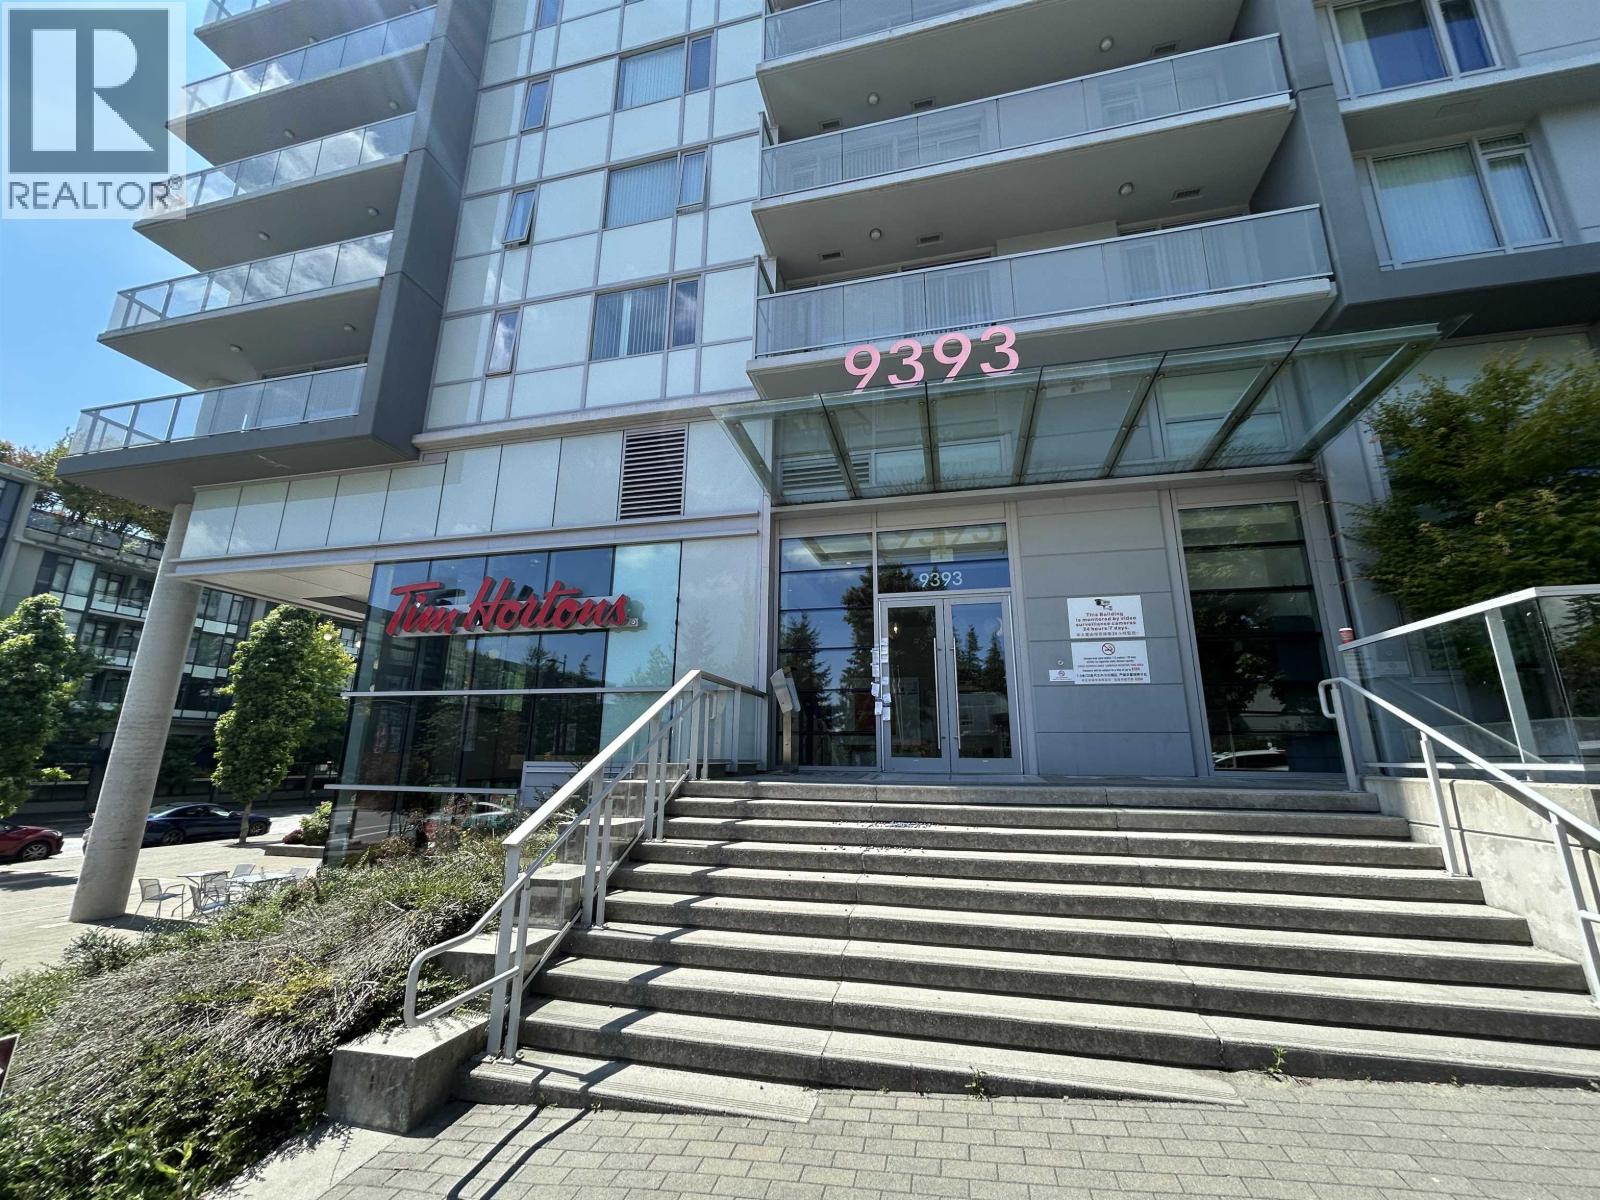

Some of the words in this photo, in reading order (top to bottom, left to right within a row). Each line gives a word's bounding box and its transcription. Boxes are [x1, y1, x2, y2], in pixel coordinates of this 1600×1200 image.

[844, 325, 1020, 394] 9393
[386, 581, 462, 636] Tim
[463, 575, 630, 632] Hortons
[919, 571, 963, 588] 9393
